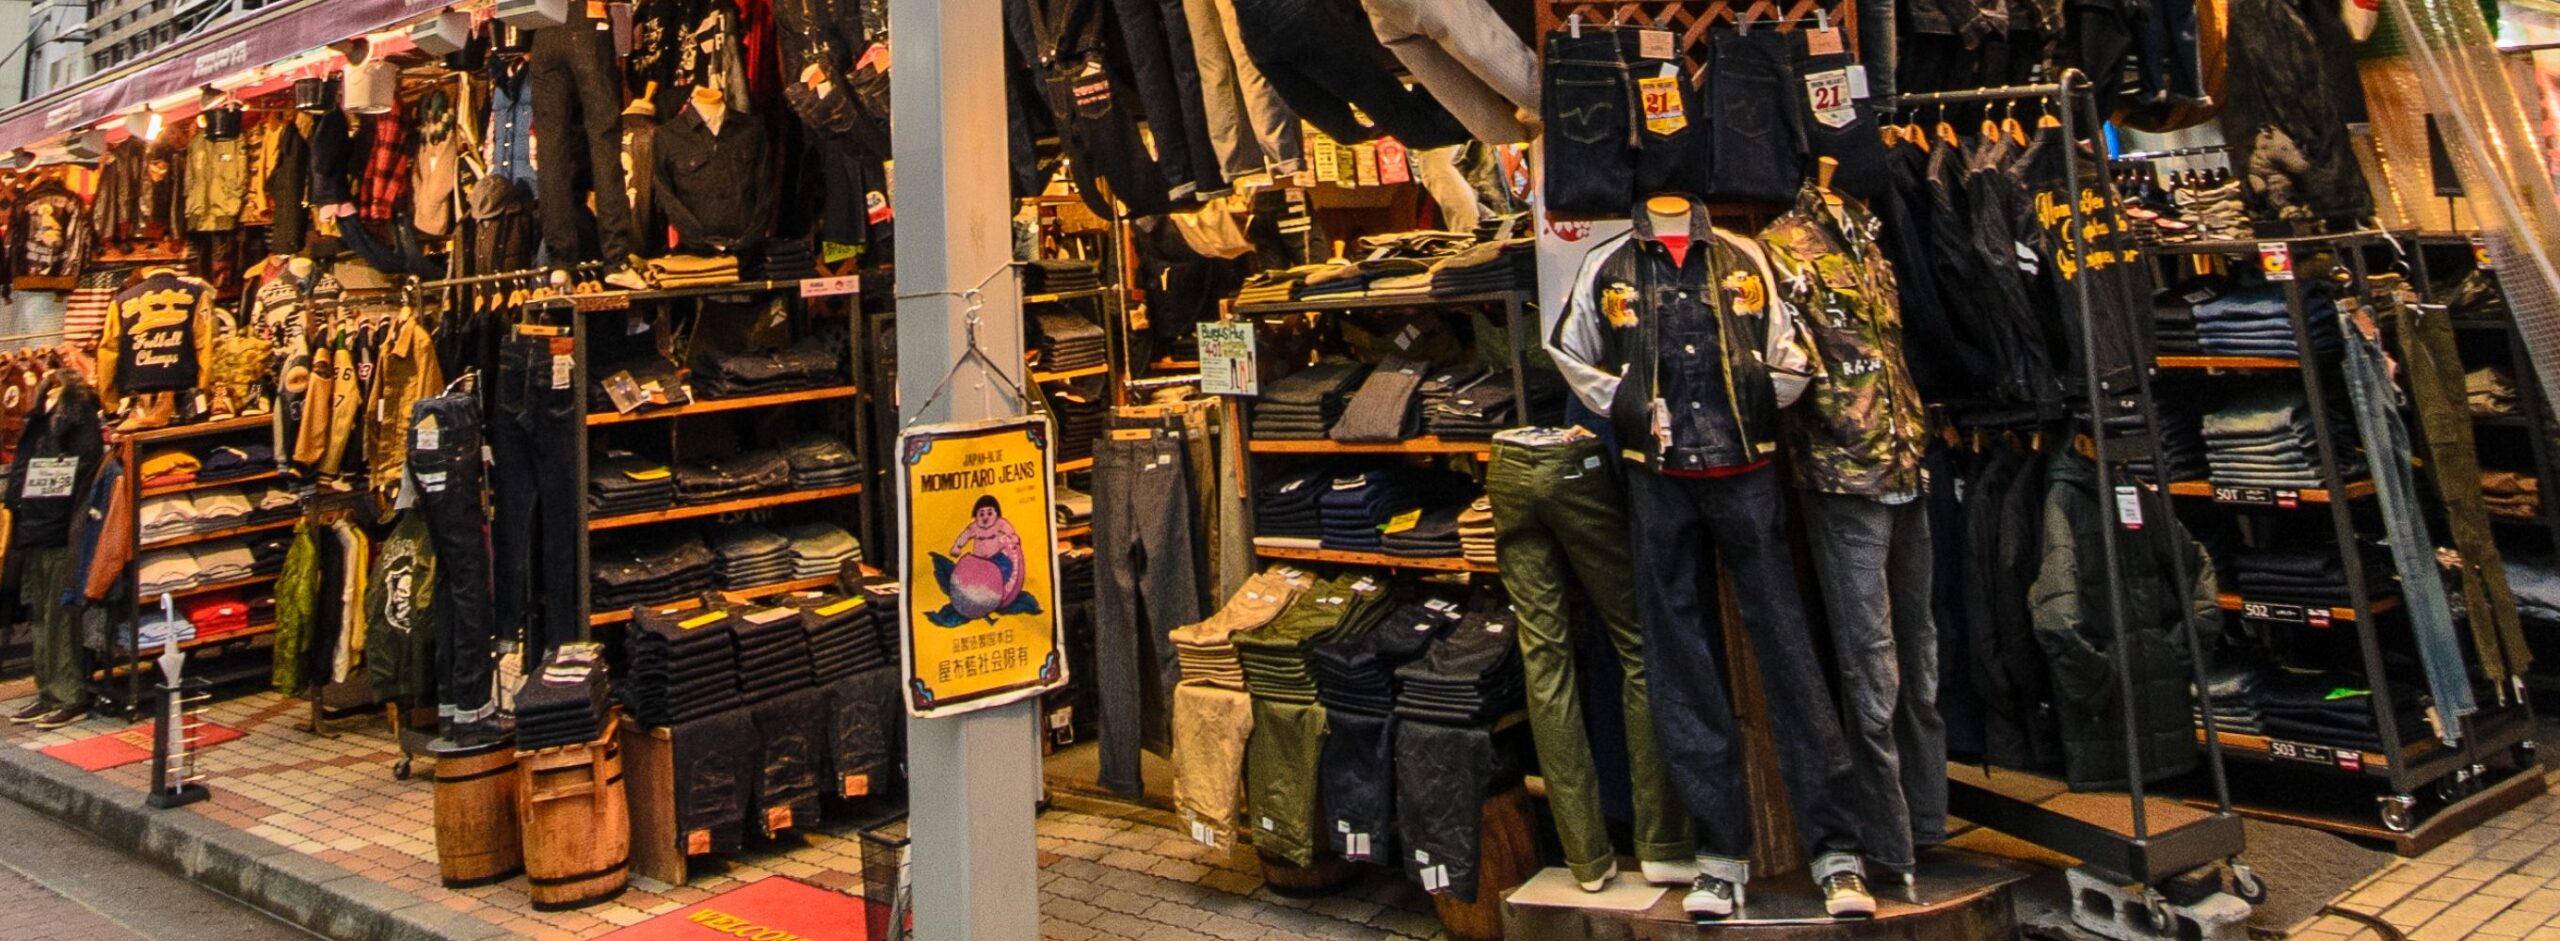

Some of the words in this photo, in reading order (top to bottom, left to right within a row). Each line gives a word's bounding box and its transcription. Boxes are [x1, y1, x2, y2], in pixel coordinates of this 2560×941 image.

[1646, 92, 1669, 113] 21
[1815, 85, 1841, 109] 21
[921, 468, 995, 493] MOMOTARO
[999, 461, 1034, 483] JEANS
[2245, 604, 2269, 617] 502
[2272, 743, 2296, 757] 503
